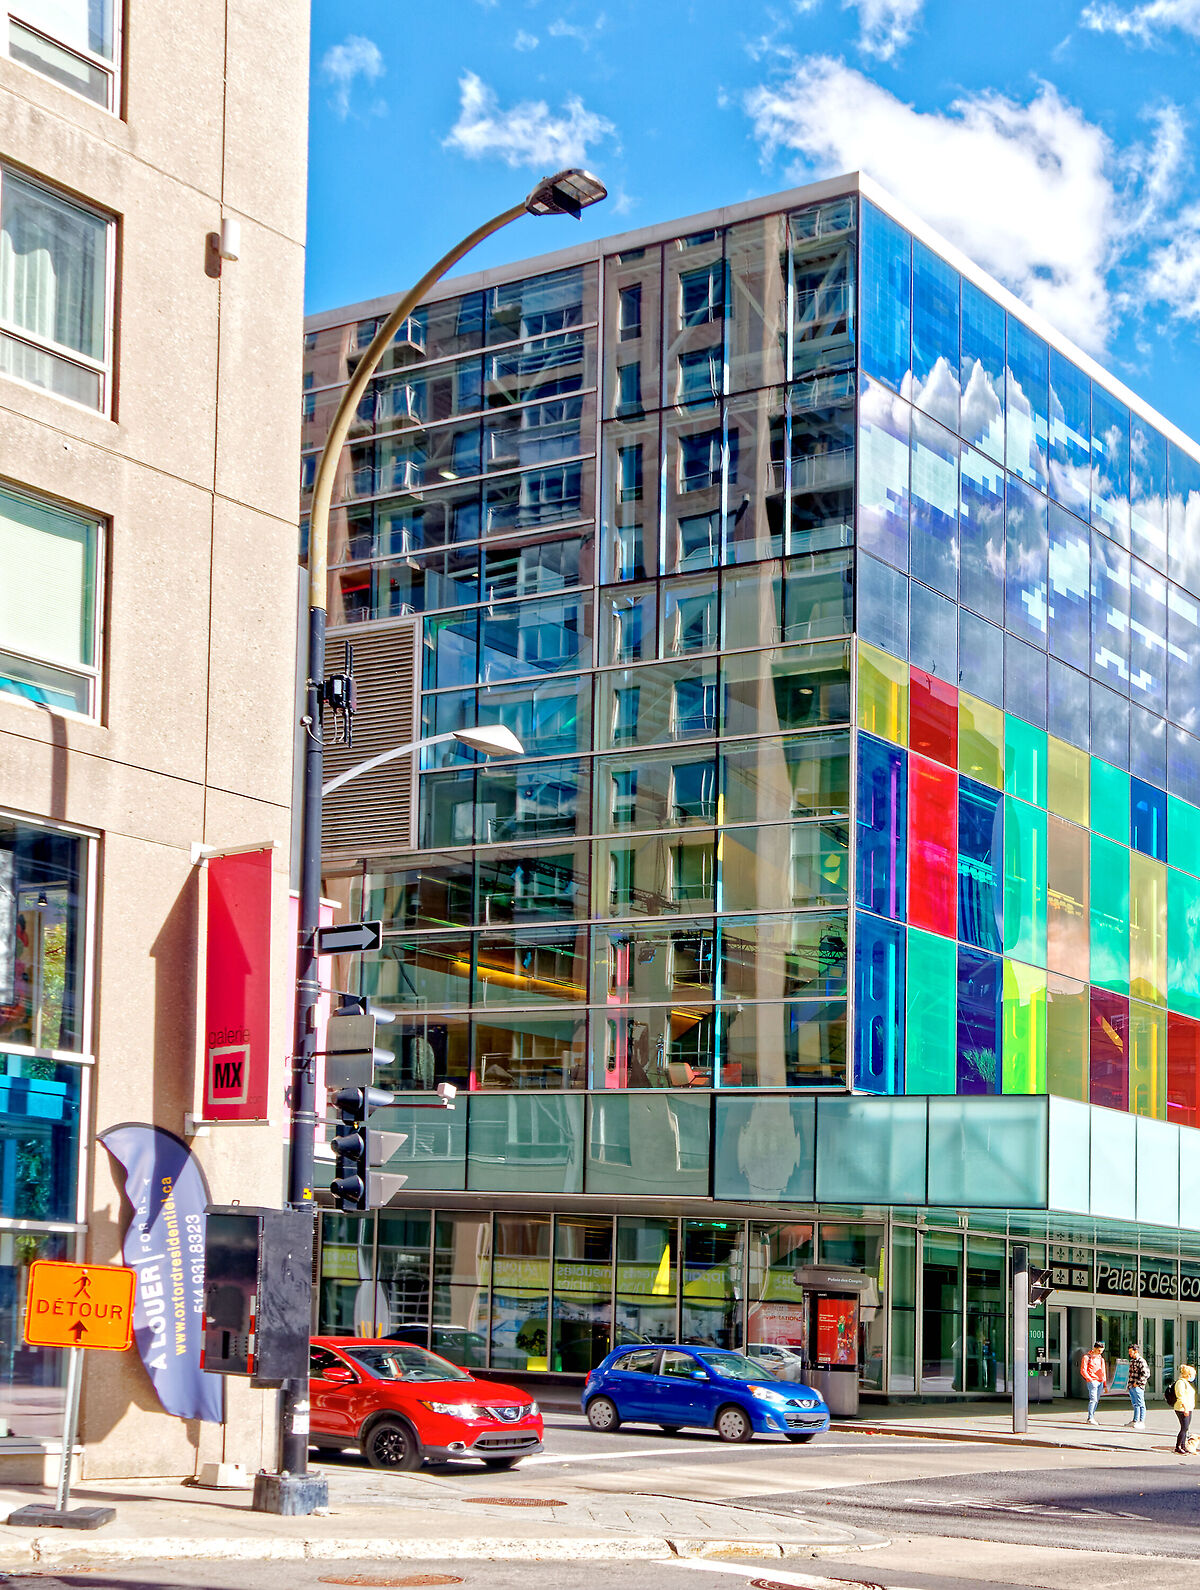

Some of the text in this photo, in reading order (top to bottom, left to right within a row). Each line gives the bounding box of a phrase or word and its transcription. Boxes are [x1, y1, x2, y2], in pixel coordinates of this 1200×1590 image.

[208, 1027, 250, 1049] galerie
[214, 1062, 242, 1089] MX
[137, 1178, 151, 1215] RT
[138, 1222, 152, 1252] FOR
[161, 1176, 187, 1356] www.oxfordresidentiel.ca
[1096, 1261, 1147, 1292] Palais
[1149, 1267, 1178, 1296] des
[36, 1298, 123, 1320] DÉTOUR
[140, 1264, 167, 1349] LOUER
[1030, 1330, 1044, 1339] 1001
